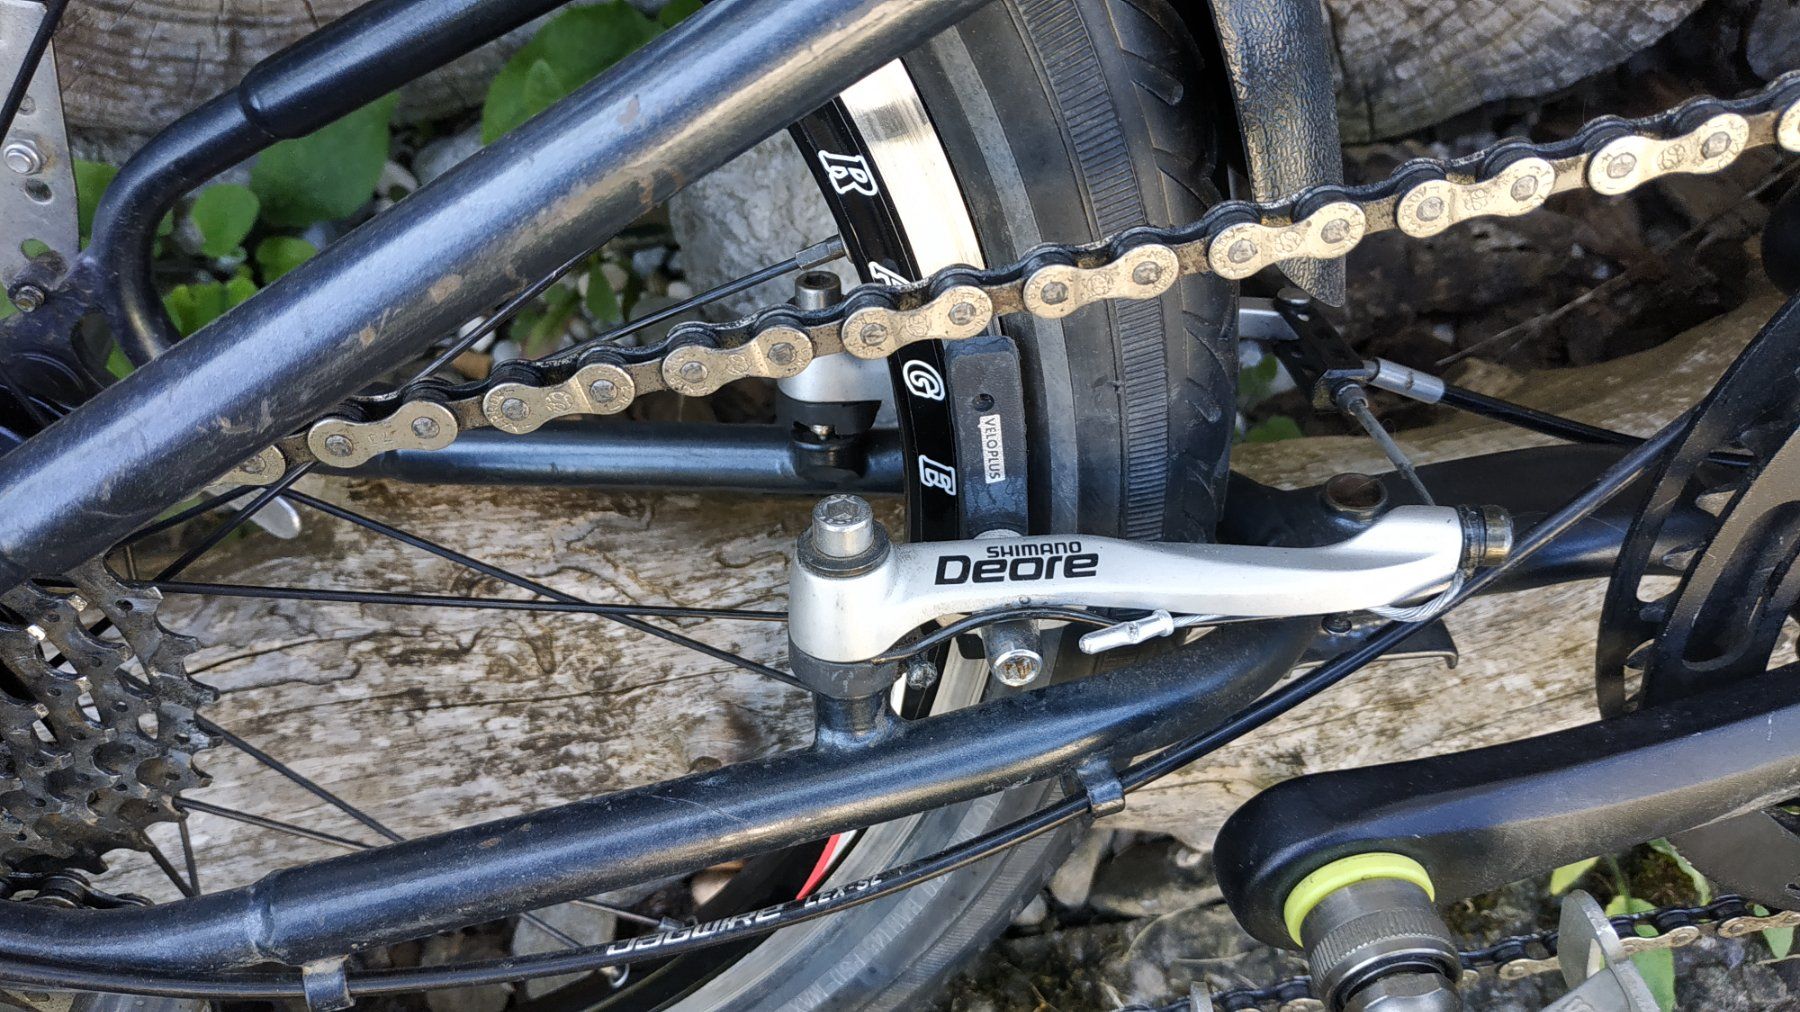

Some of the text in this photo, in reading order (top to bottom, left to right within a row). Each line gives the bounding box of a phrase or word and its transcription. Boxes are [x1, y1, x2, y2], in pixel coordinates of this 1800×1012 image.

[984, 417, 1001, 480] VELOPLUS
[986, 541, 1082, 558] SHIMANO
[934, 552, 1099, 585] Deore
